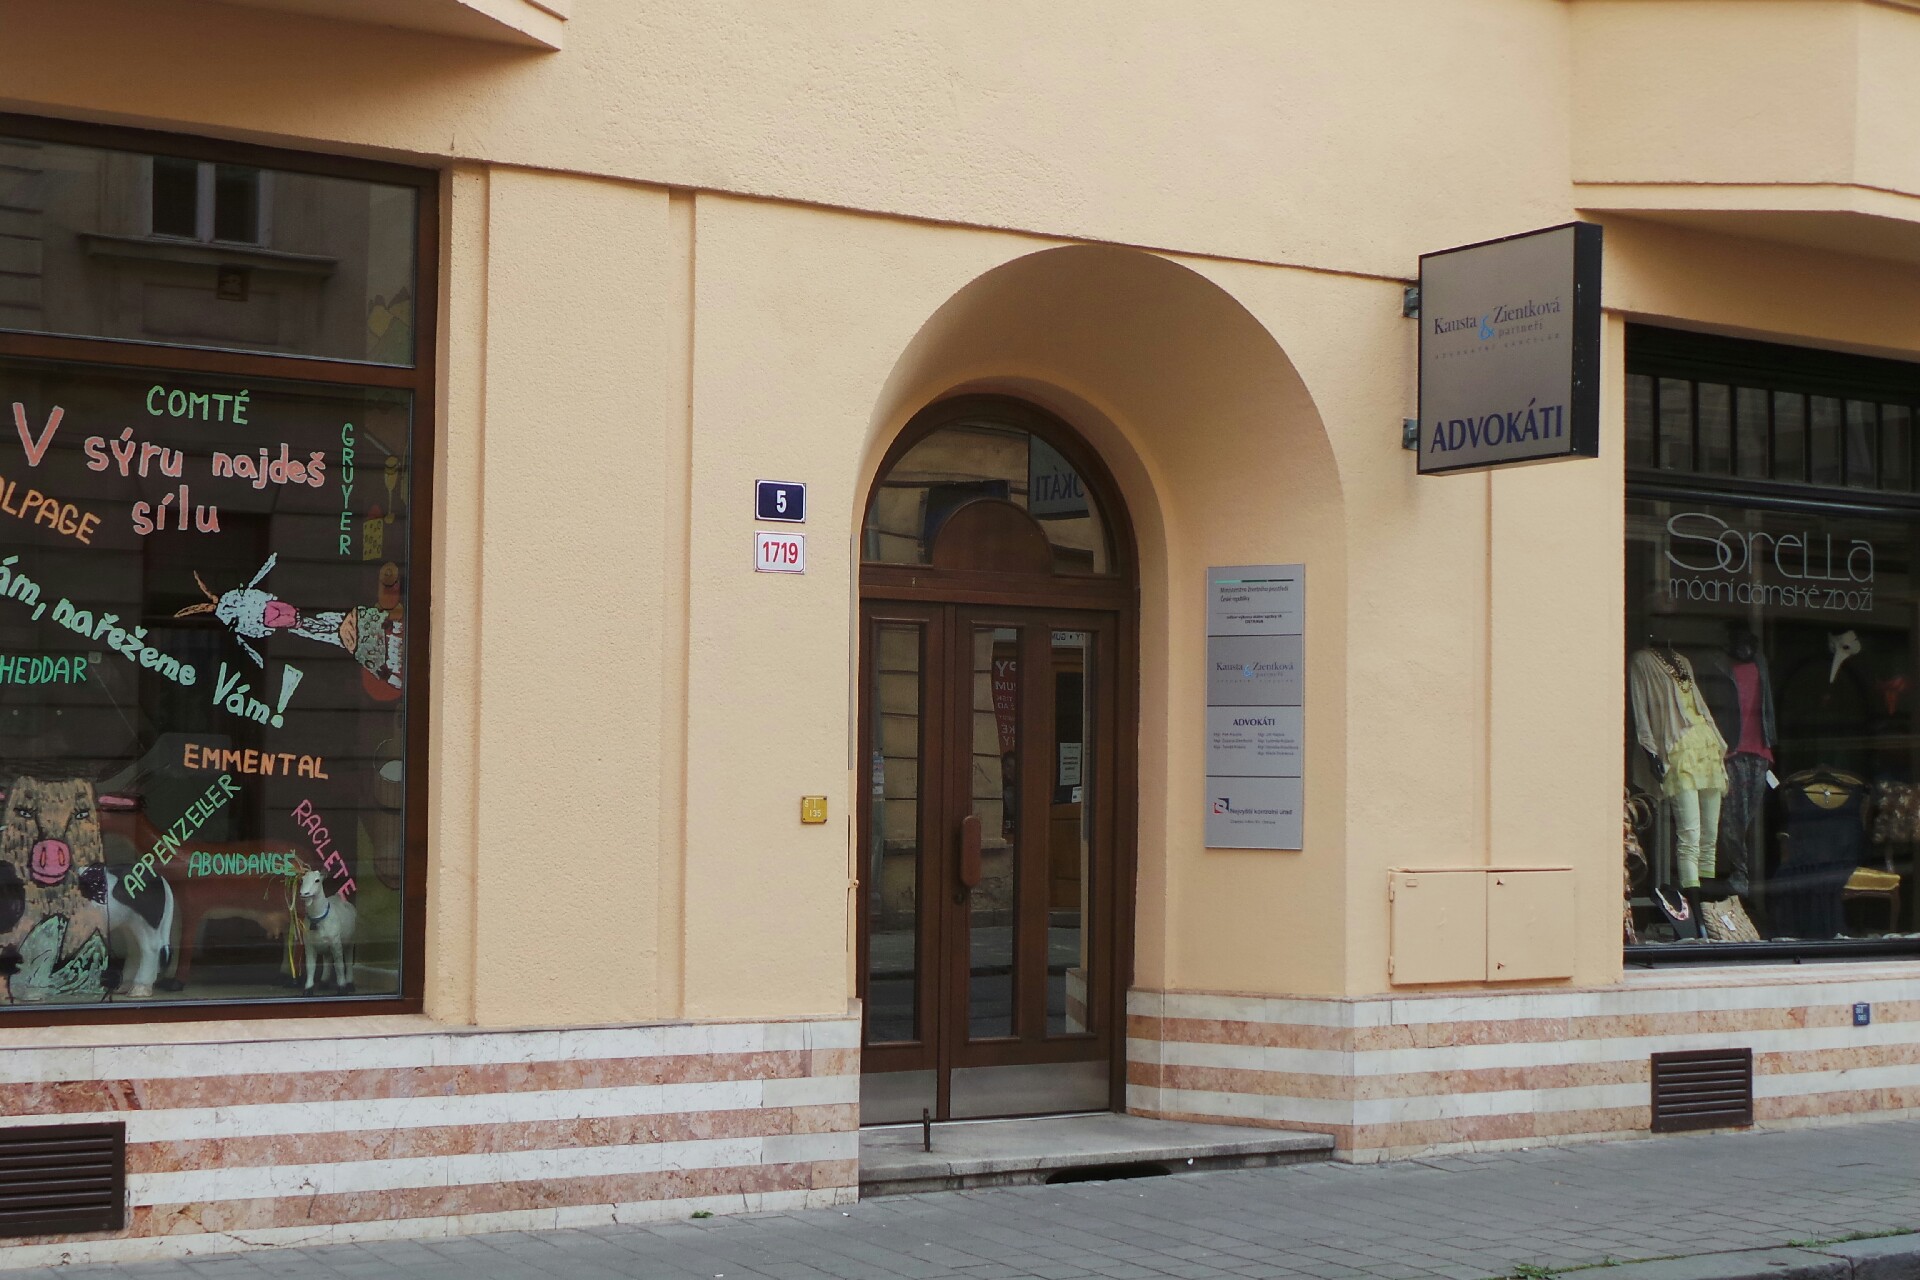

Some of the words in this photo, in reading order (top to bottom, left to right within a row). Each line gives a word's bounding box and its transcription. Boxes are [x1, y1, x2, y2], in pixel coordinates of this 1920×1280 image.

[1434, 316, 1477, 335] Kausta
[1493, 297, 1561, 324] Zientková
[145, 385, 251, 425] COMTÉ
[1430, 397, 1564, 453] ADVOKÁTI
[12, 401, 65, 467] V
[83, 427, 184, 478] sýru
[212, 442, 327, 490] najdeš
[339, 422, 355, 556] GRUYER
[776, 489, 787, 514] 5
[131, 485, 221, 536] sílu
[762, 541, 799, 564] 1719
[1668, 575, 1735, 603] módní
[1736, 579, 1821, 609] dámské
[1822, 587, 1874, 612] zboží
[52, 598, 198, 687] nařežeme
[212, 661, 304, 729] Vám!
[1216, 662, 1243, 671] Kausta
[1232, 716, 1276, 726] ADVOKÁTI
[183, 743, 329, 780] EMMENTAL
[123, 773, 242, 899] APPENZELLER
